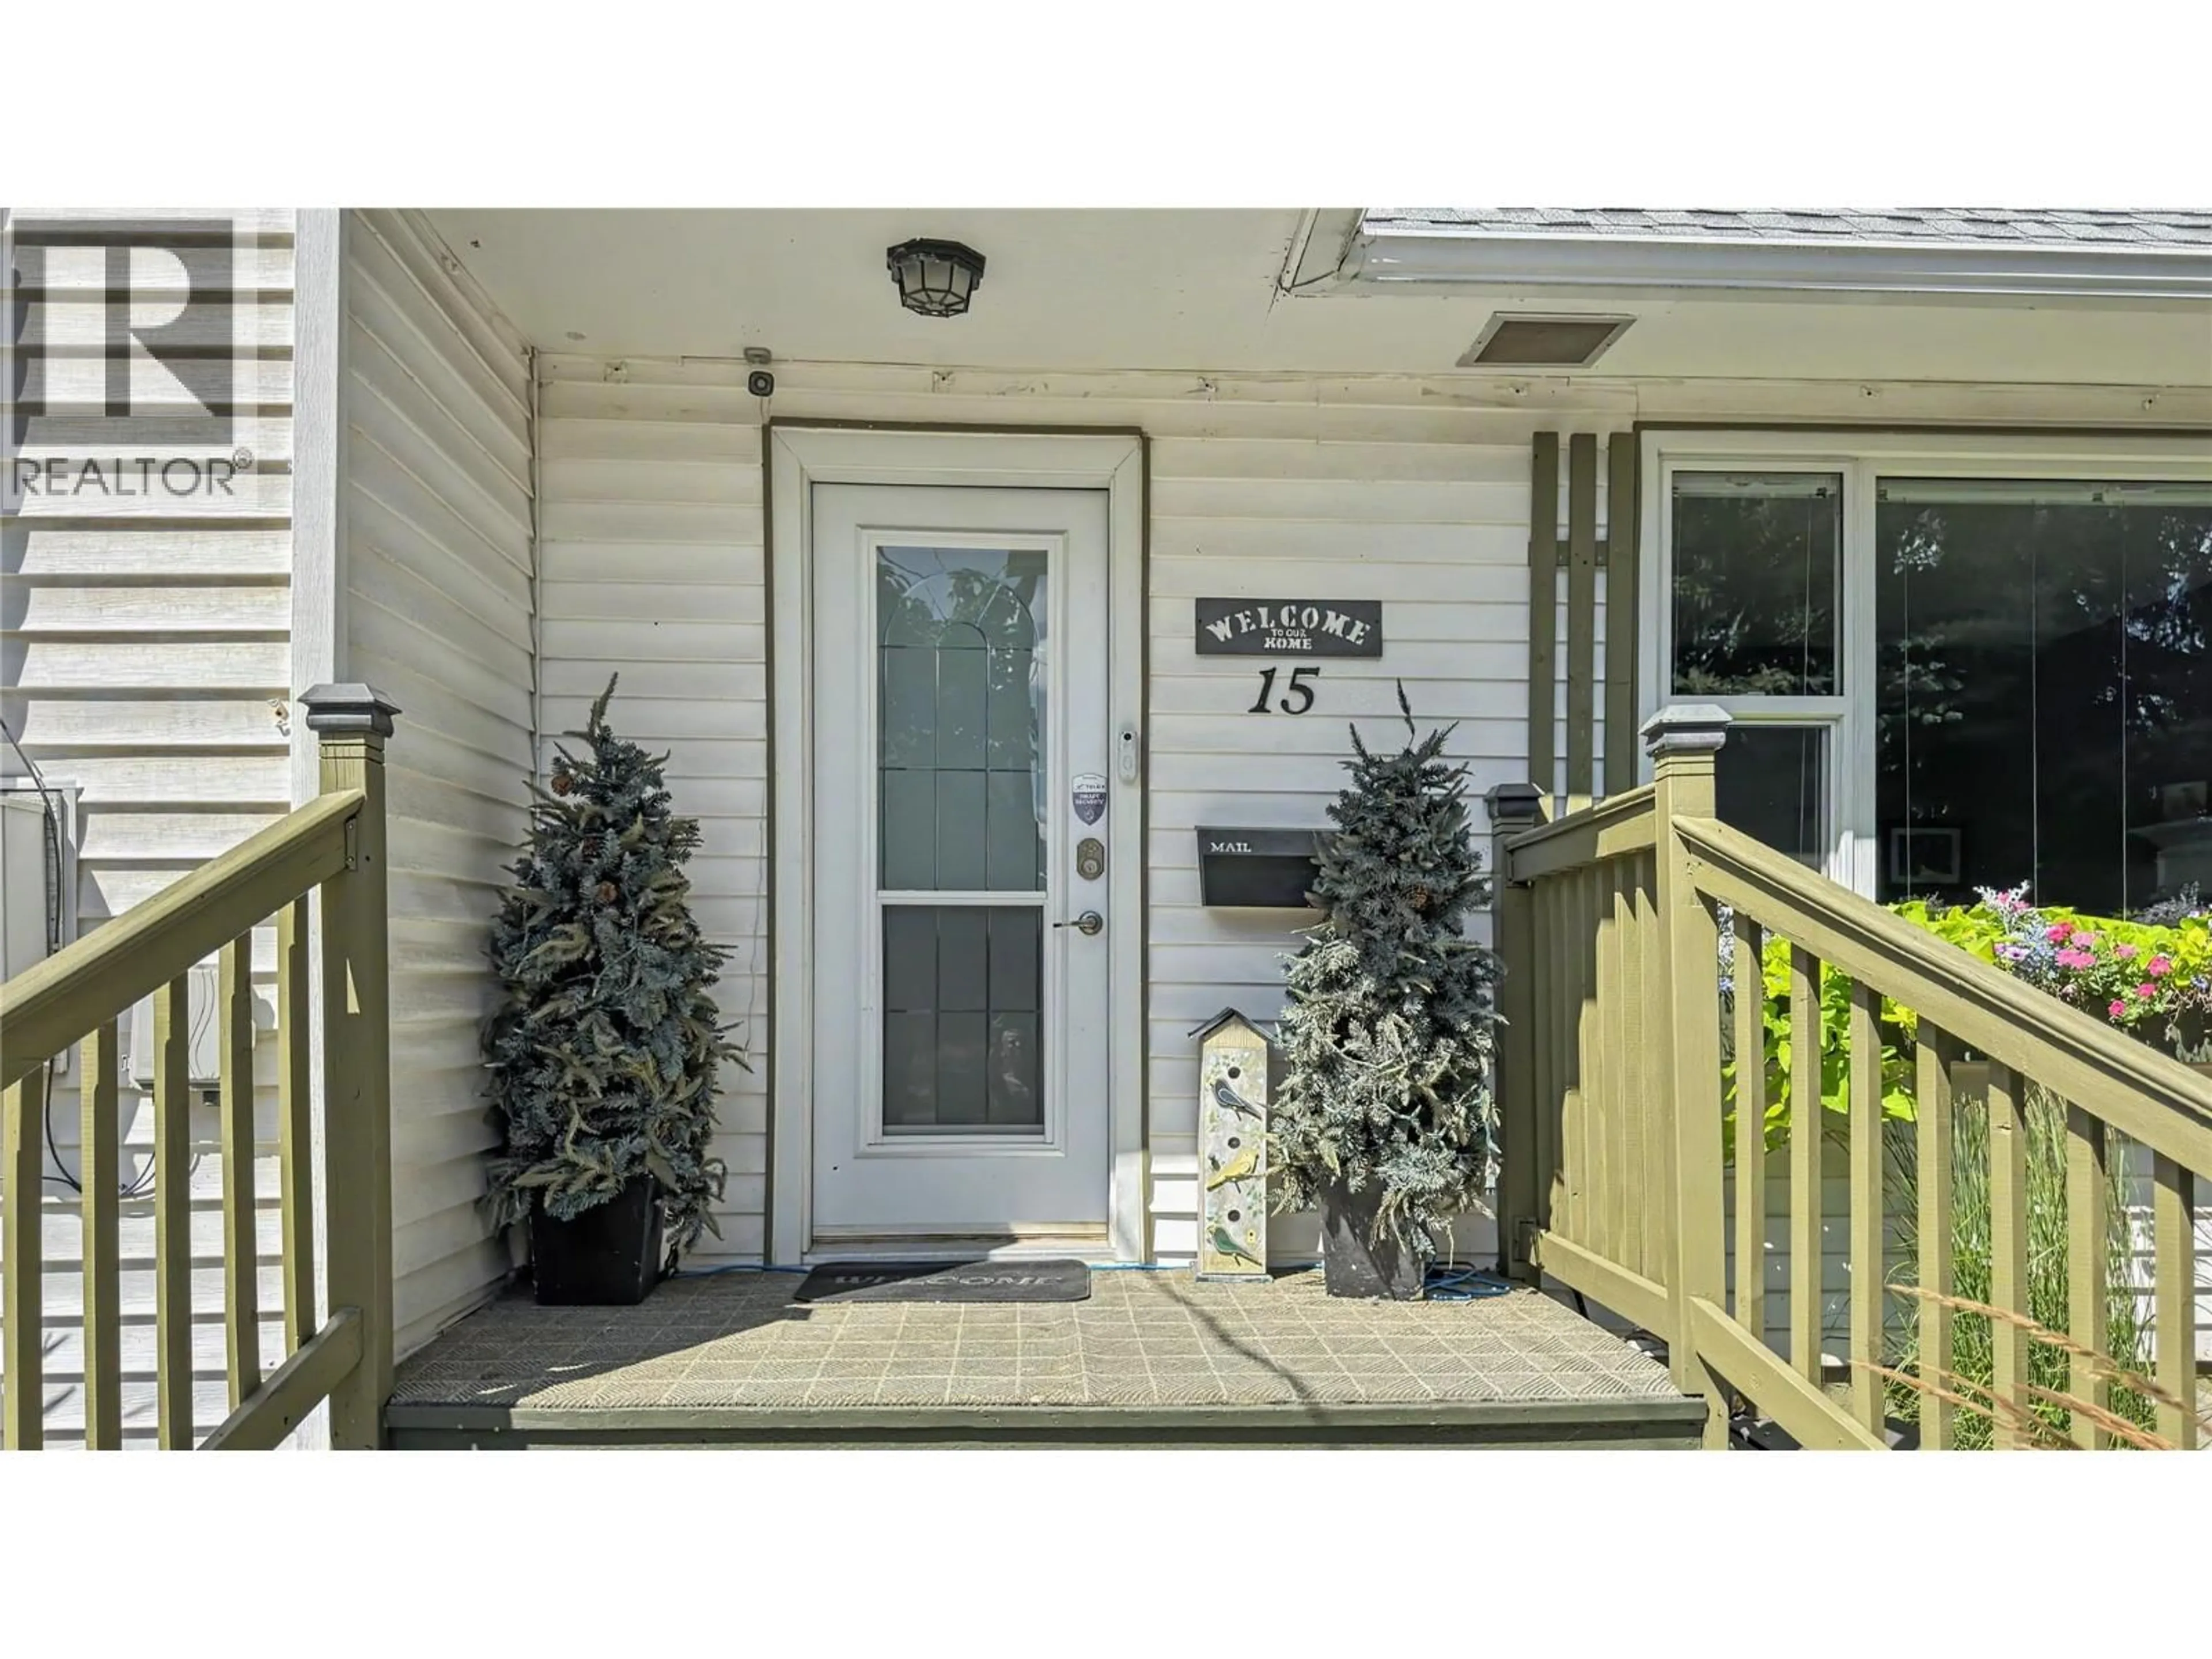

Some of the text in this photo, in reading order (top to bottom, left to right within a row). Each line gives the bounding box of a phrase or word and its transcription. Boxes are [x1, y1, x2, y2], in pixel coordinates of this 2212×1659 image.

[1206, 605, 1371, 645] WELCOME
[1271, 628, 1306, 638] TO OUR
[1264, 637, 1313, 650] HOME
[1248, 666, 1320, 715] 15
[1210, 842, 1252, 853] MAIL
